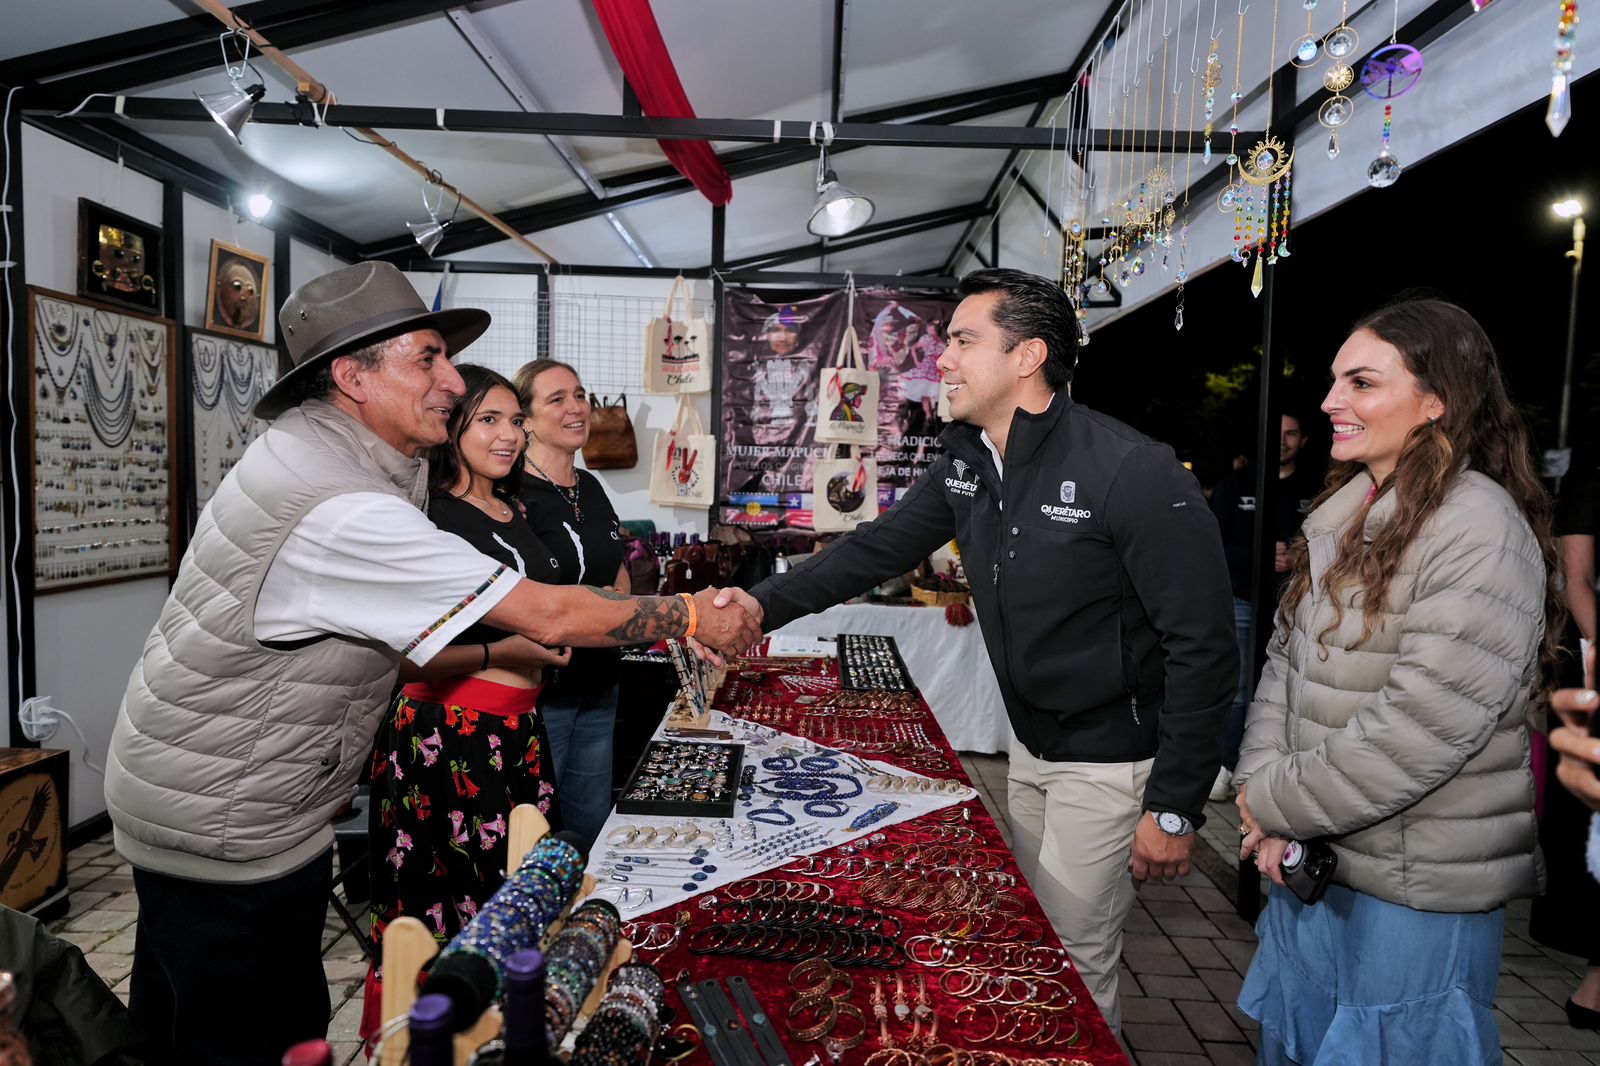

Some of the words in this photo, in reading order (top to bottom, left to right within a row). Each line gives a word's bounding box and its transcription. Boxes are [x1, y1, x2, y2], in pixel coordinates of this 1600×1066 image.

[726, 445, 771, 457] MUJER
[775, 446, 829, 459] MAPUC
[898, 466, 911, 477] DE
[761, 474, 803, 487] CHILE
[945, 477, 978, 492] QUERÉTA
[961, 490, 975, 498] FUTU
[1040, 504, 1092, 519] QUERÉTARO
[1050, 515, 1079, 525] MUNICIPIO
